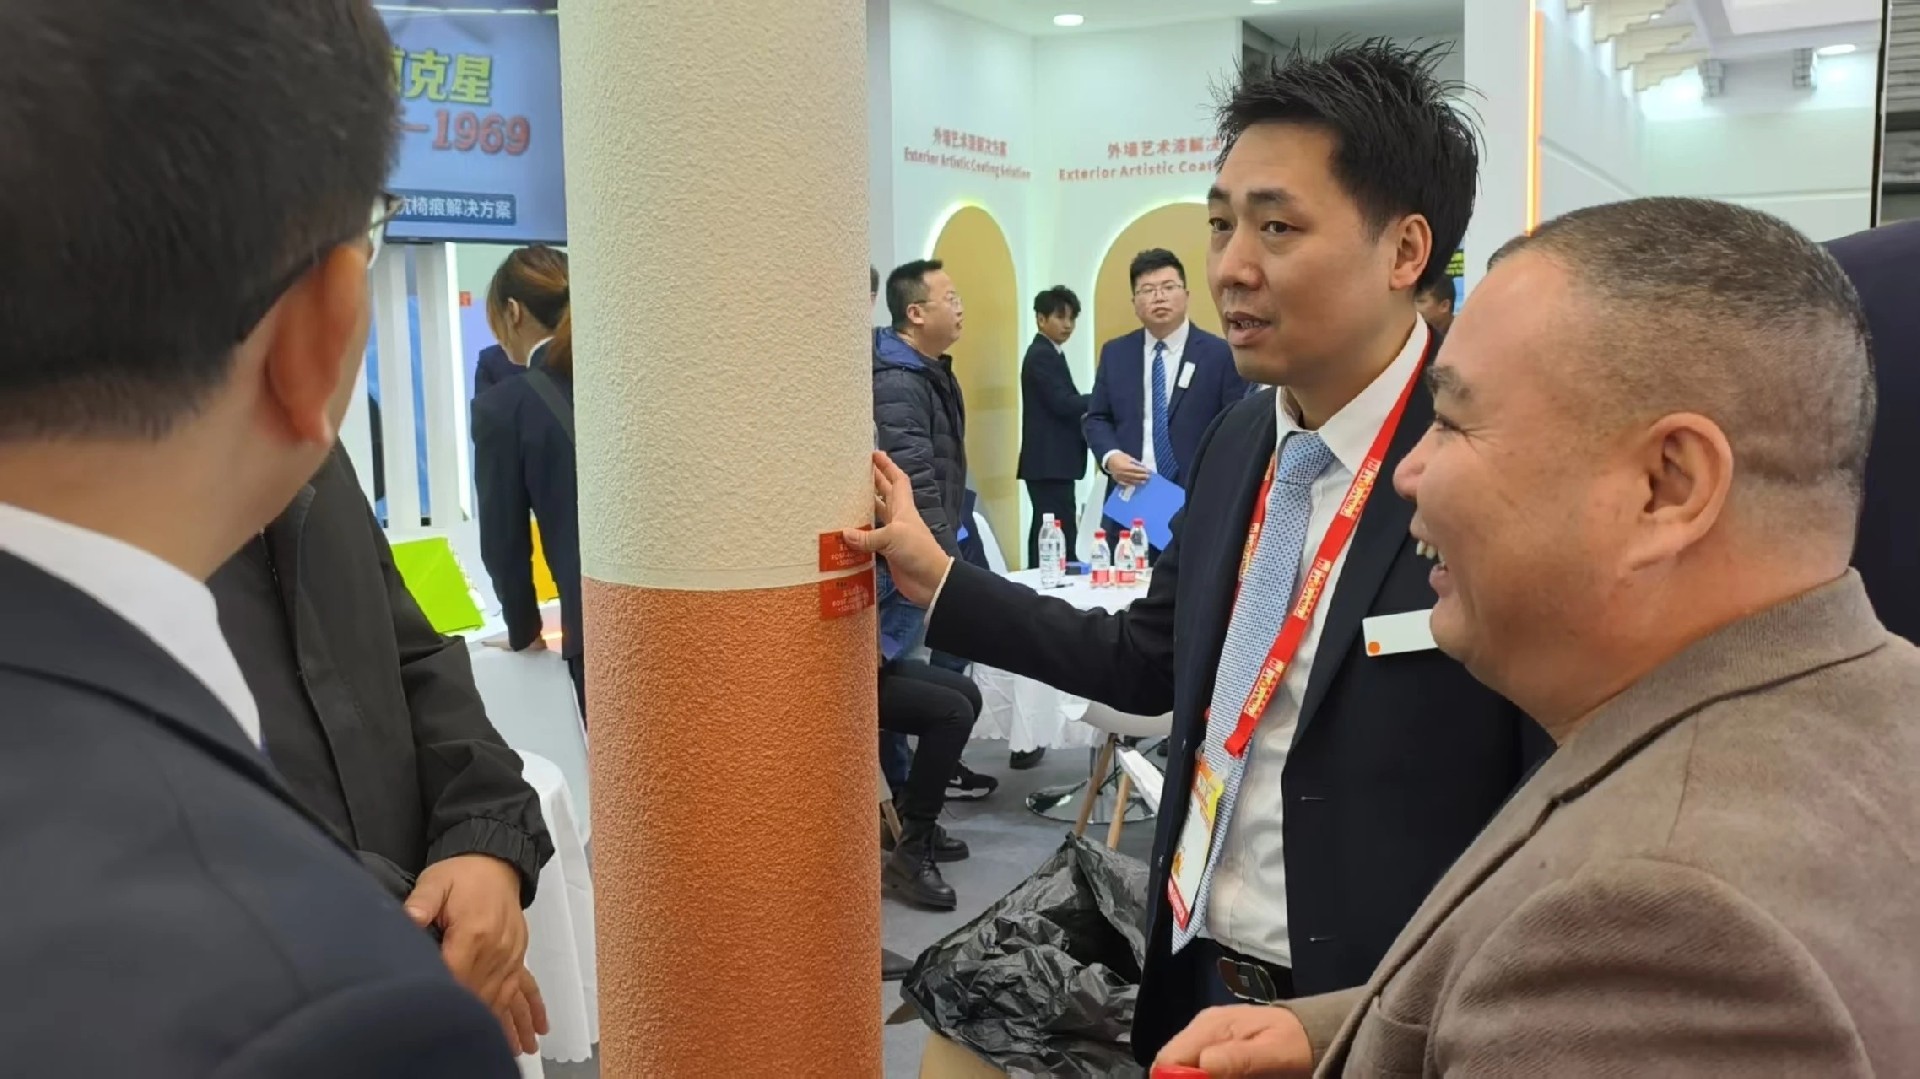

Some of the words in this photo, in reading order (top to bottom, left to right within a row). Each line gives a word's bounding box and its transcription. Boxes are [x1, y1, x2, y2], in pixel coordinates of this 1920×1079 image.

[941, 153, 968, 170] Artistic
[1059, 166, 1116, 181] Exterior
[1120, 161, 1174, 177] Artistic
